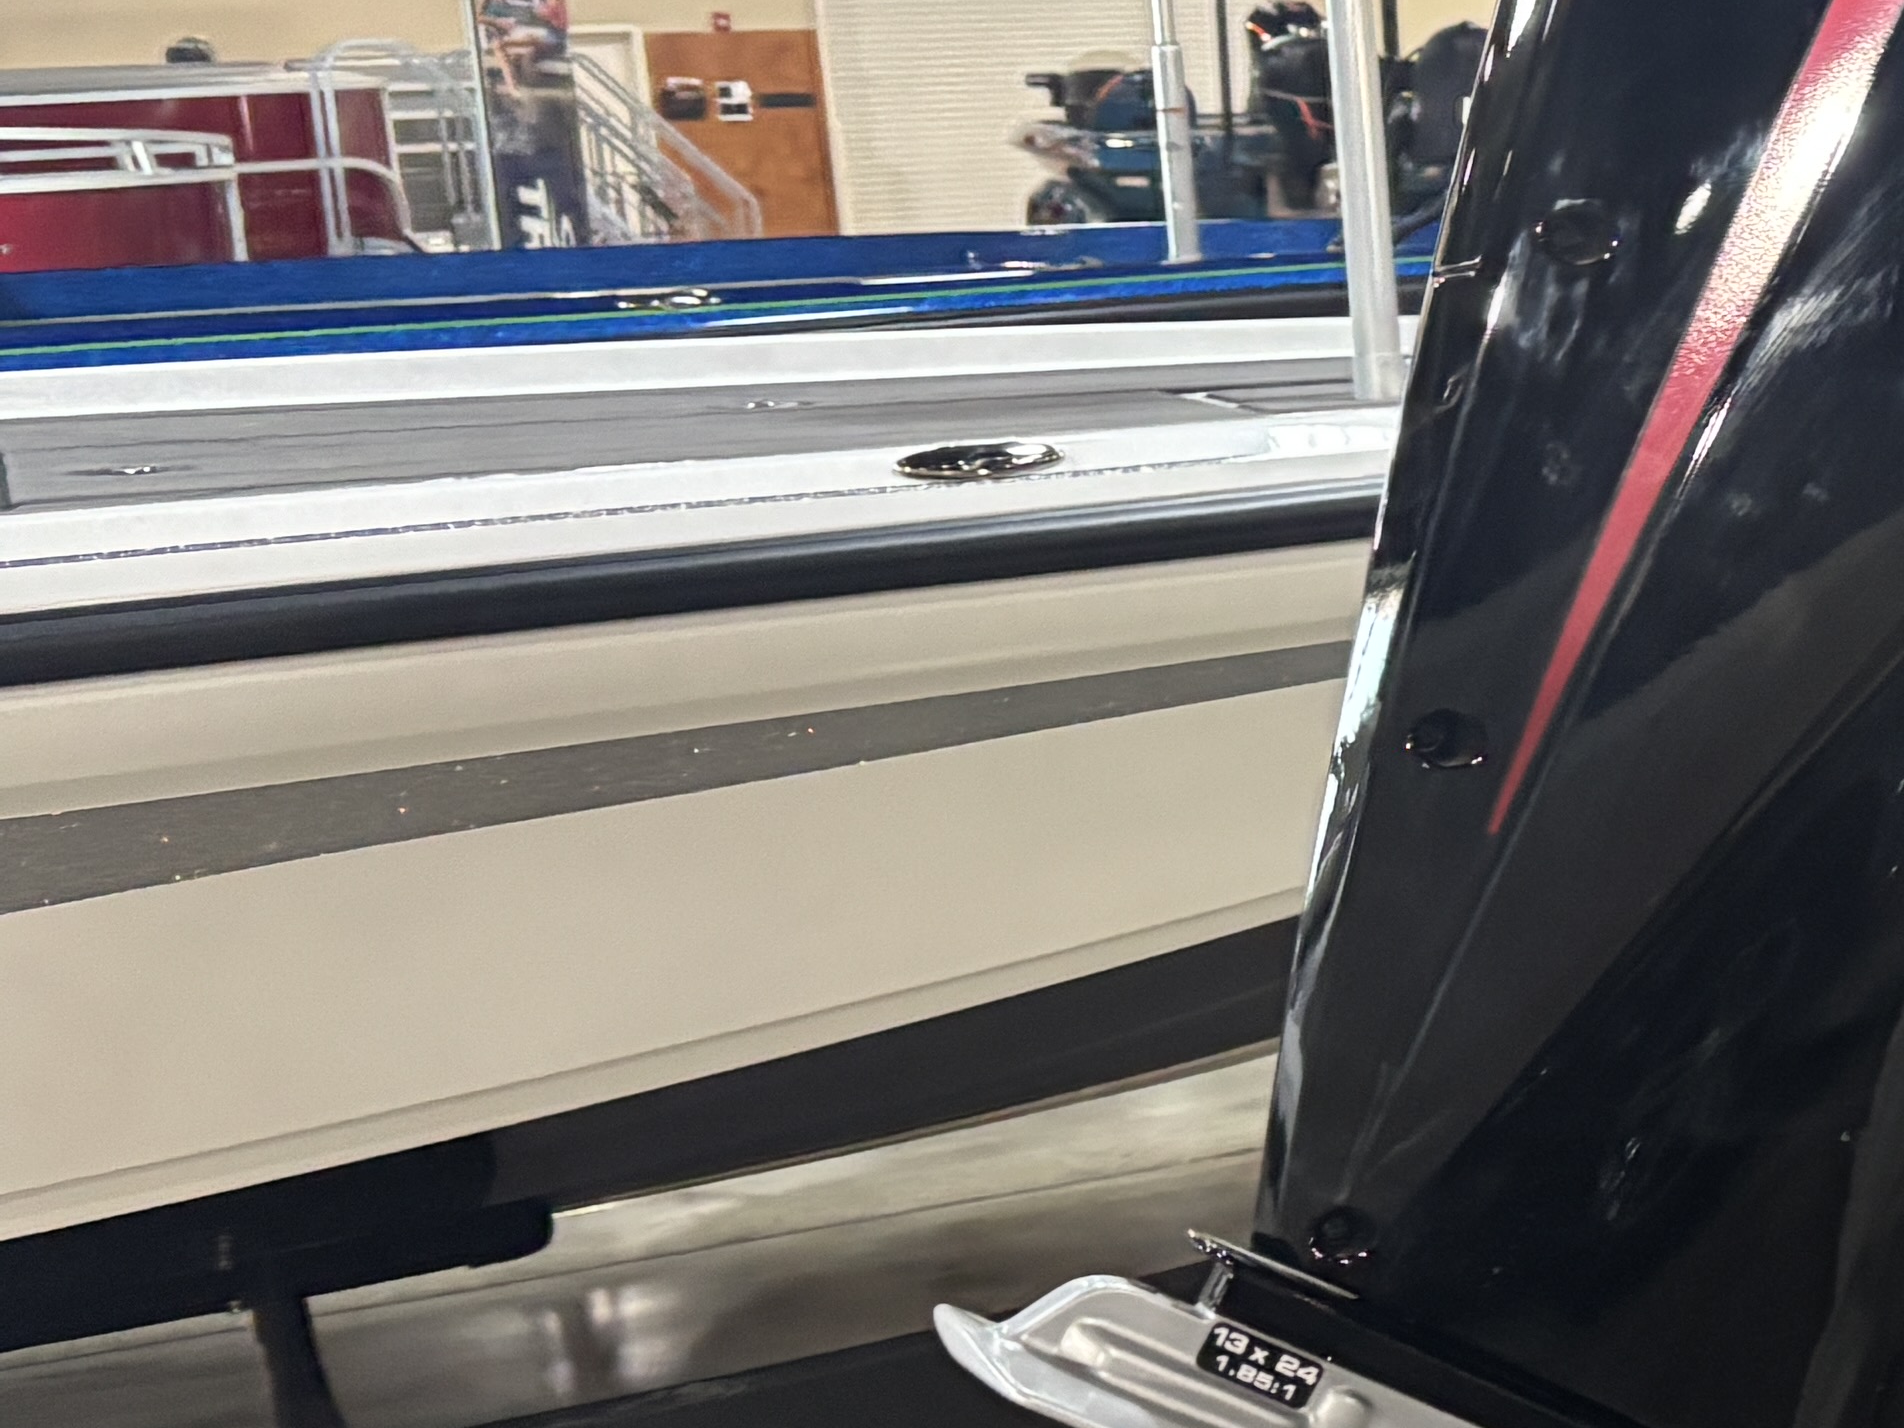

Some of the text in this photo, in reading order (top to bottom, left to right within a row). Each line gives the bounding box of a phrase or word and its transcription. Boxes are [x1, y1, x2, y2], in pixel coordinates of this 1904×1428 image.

[1213, 1327, 1250, 1356] 13
[1275, 1354, 1319, 1386] 24
[1216, 1355, 1297, 1401] 1.85:1
